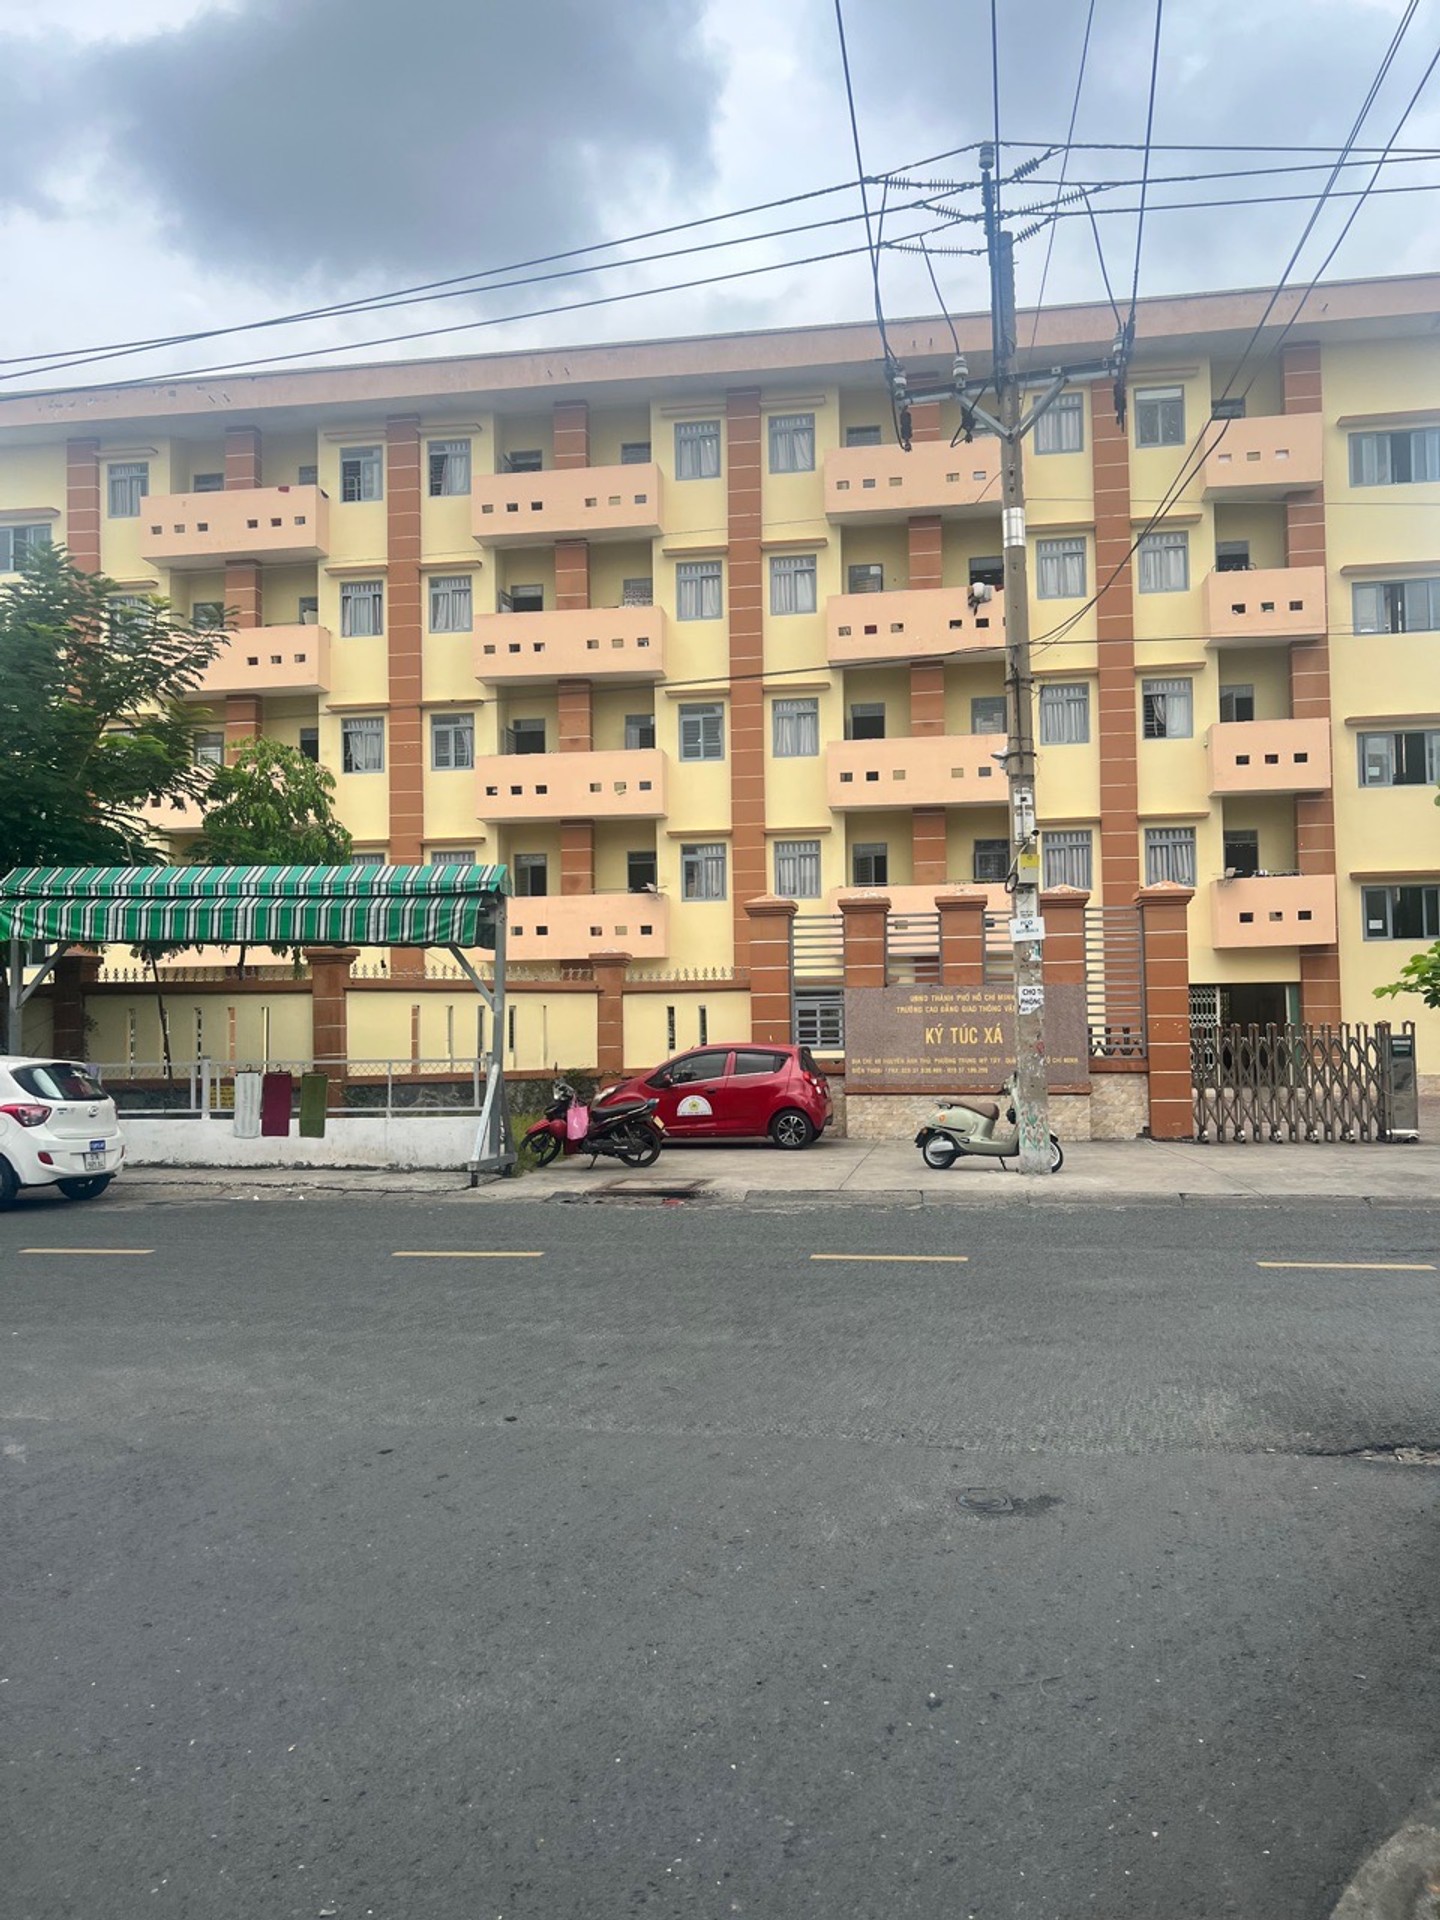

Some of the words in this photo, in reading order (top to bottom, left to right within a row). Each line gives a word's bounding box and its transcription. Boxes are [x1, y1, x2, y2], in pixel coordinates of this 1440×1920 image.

[931, 992, 954, 1002] THÀNH
[972, 990, 982, 1001] HỒ
[896, 1004, 924, 1014] TRƯỜNG
[925, 1006, 938, 1014] CAO
[961, 1005, 977, 1013] GIAO
[979, 1003, 1001, 1013] THÔNG
[925, 1023, 944, 1044] KÝ
[950, 1023, 978, 1044] TÚC
[984, 1023, 1003, 1044] XÁ
